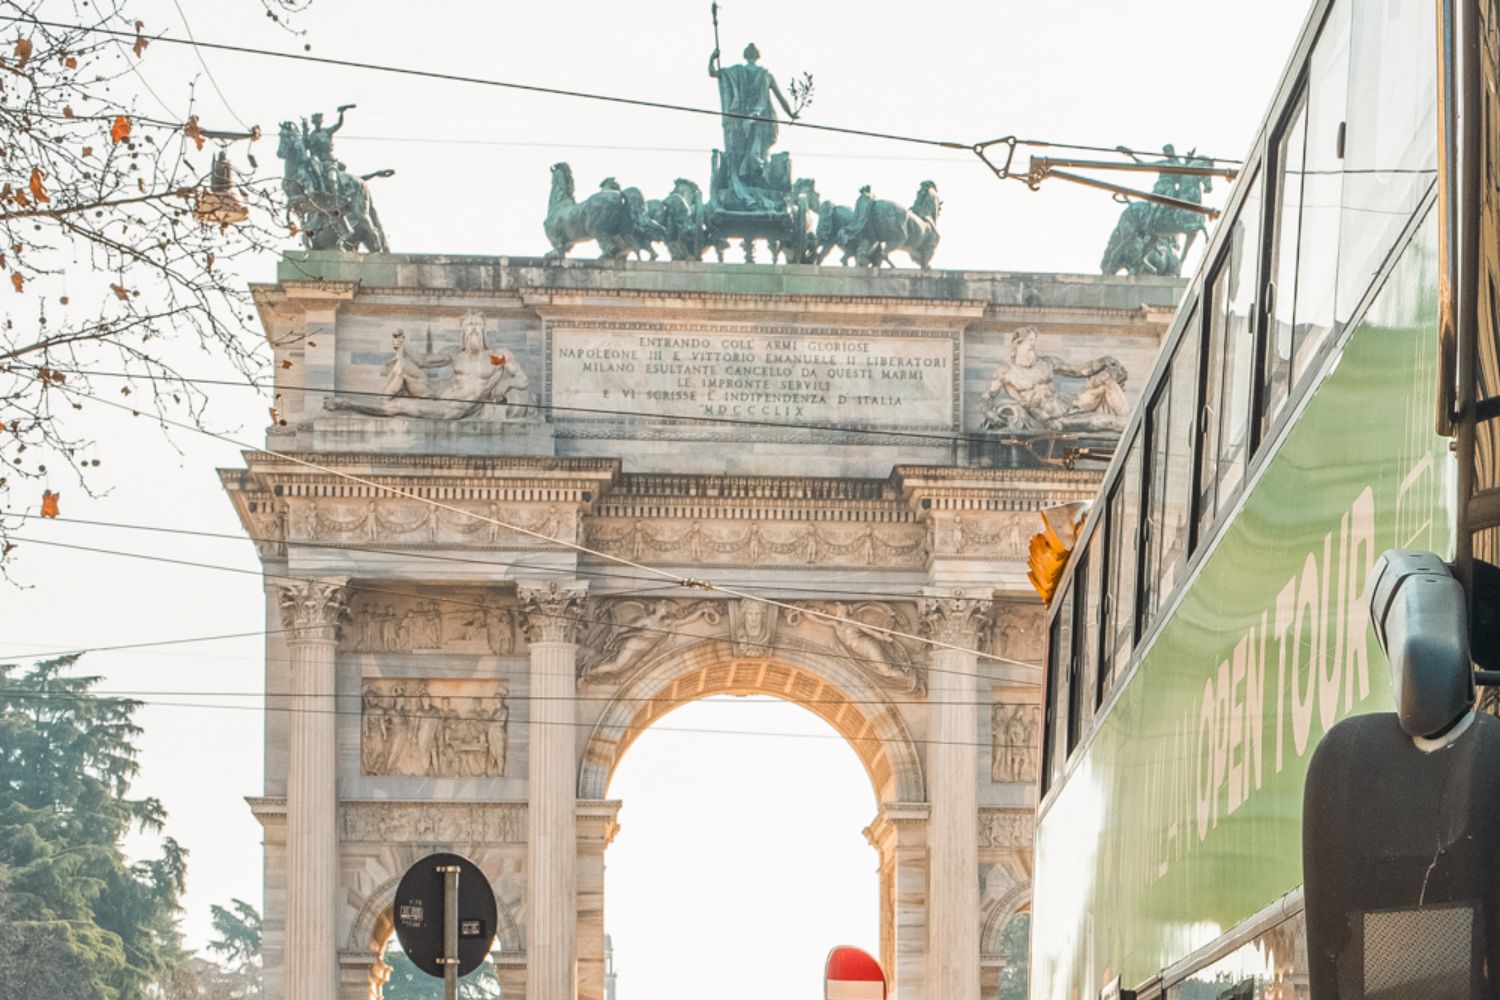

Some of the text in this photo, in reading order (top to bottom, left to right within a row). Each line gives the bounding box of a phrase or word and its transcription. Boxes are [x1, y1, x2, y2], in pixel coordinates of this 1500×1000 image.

[639, 337, 710, 348] ENTRANDO
[765, 340, 797, 351] ARMI
[808, 341, 870, 353] GLORIOSE
[558, 348, 946, 368] NAPOLEONE III E VITTORIO EMANUELE II LIBERATORI
[582, 362, 635, 374] MILANO
[645, 364, 716, 375] ESULTANTE
[801, 368, 817, 378] DA
[827, 368, 872, 380] QUESTI
[881, 369, 924, 381] MARMI
[677, 378, 830, 392] LE IMPRONTE SERVILI
[725, 391, 827, 405] INDIPENDENZA
[857, 395, 903, 407] ITALIA
[1196, 609, 1268, 843] OPEN
[1274, 485, 1375, 775] TOUR
